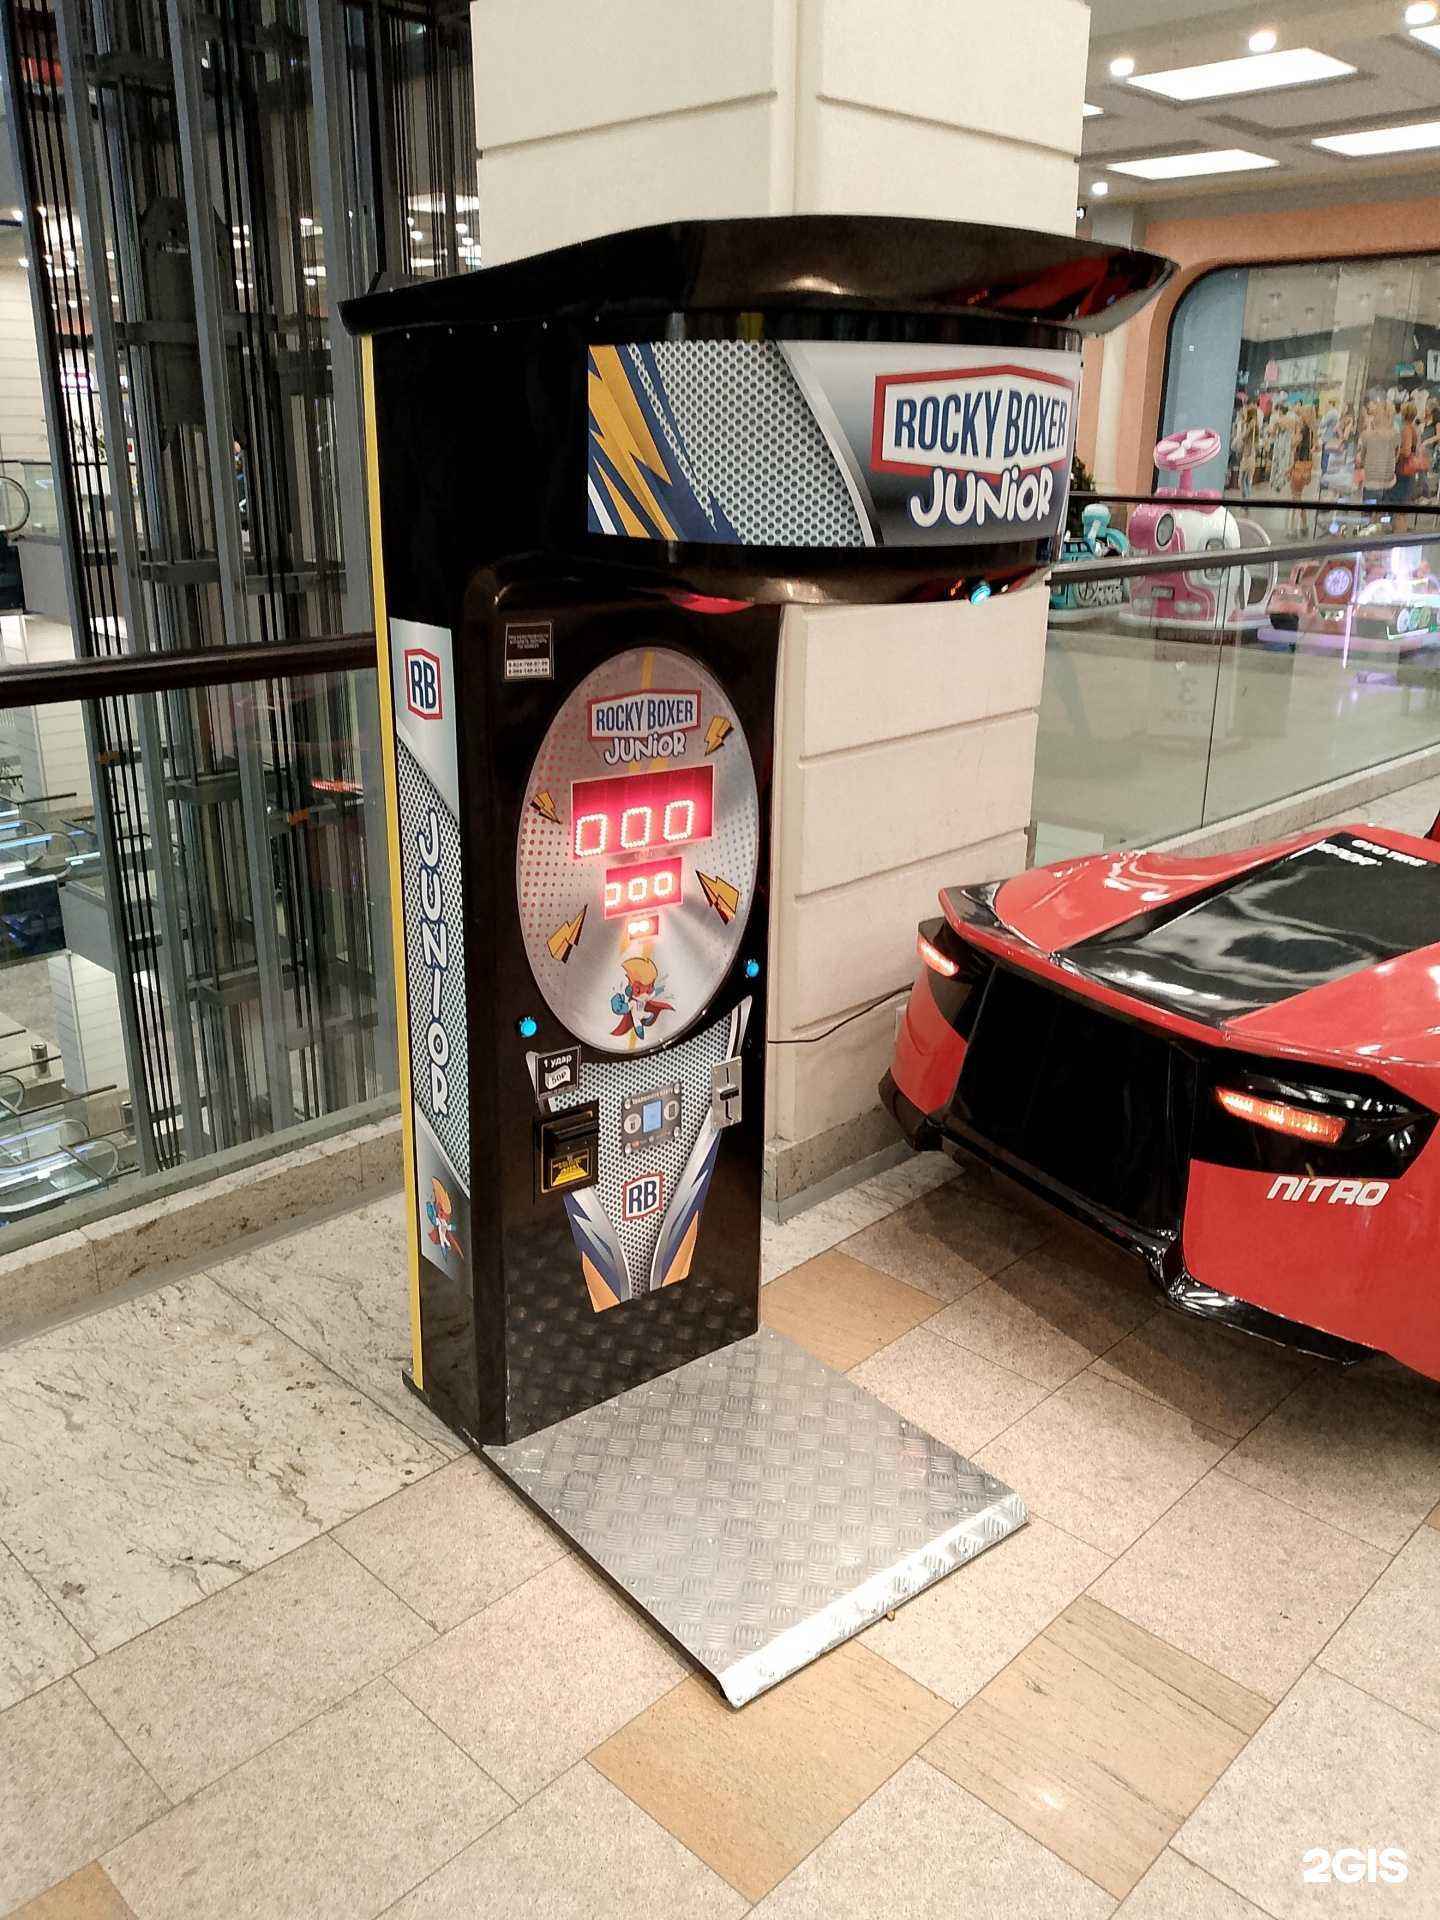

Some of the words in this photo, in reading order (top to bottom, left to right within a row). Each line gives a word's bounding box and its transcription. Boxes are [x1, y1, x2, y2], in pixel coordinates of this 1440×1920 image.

[894, 390, 1002, 459] ROCKY
[1003, 390, 1067, 458] BOXER
[410, 660, 437, 709] RB
[596, 701, 643, 731] ROCKY
[647, 699, 693, 730] BOXER
[417, 811, 448, 1115] JUNIOR
[550, 1054, 572, 1068] удар
[628, 1180, 657, 1214] RB
[1266, 1175, 1390, 1207] NITRO
